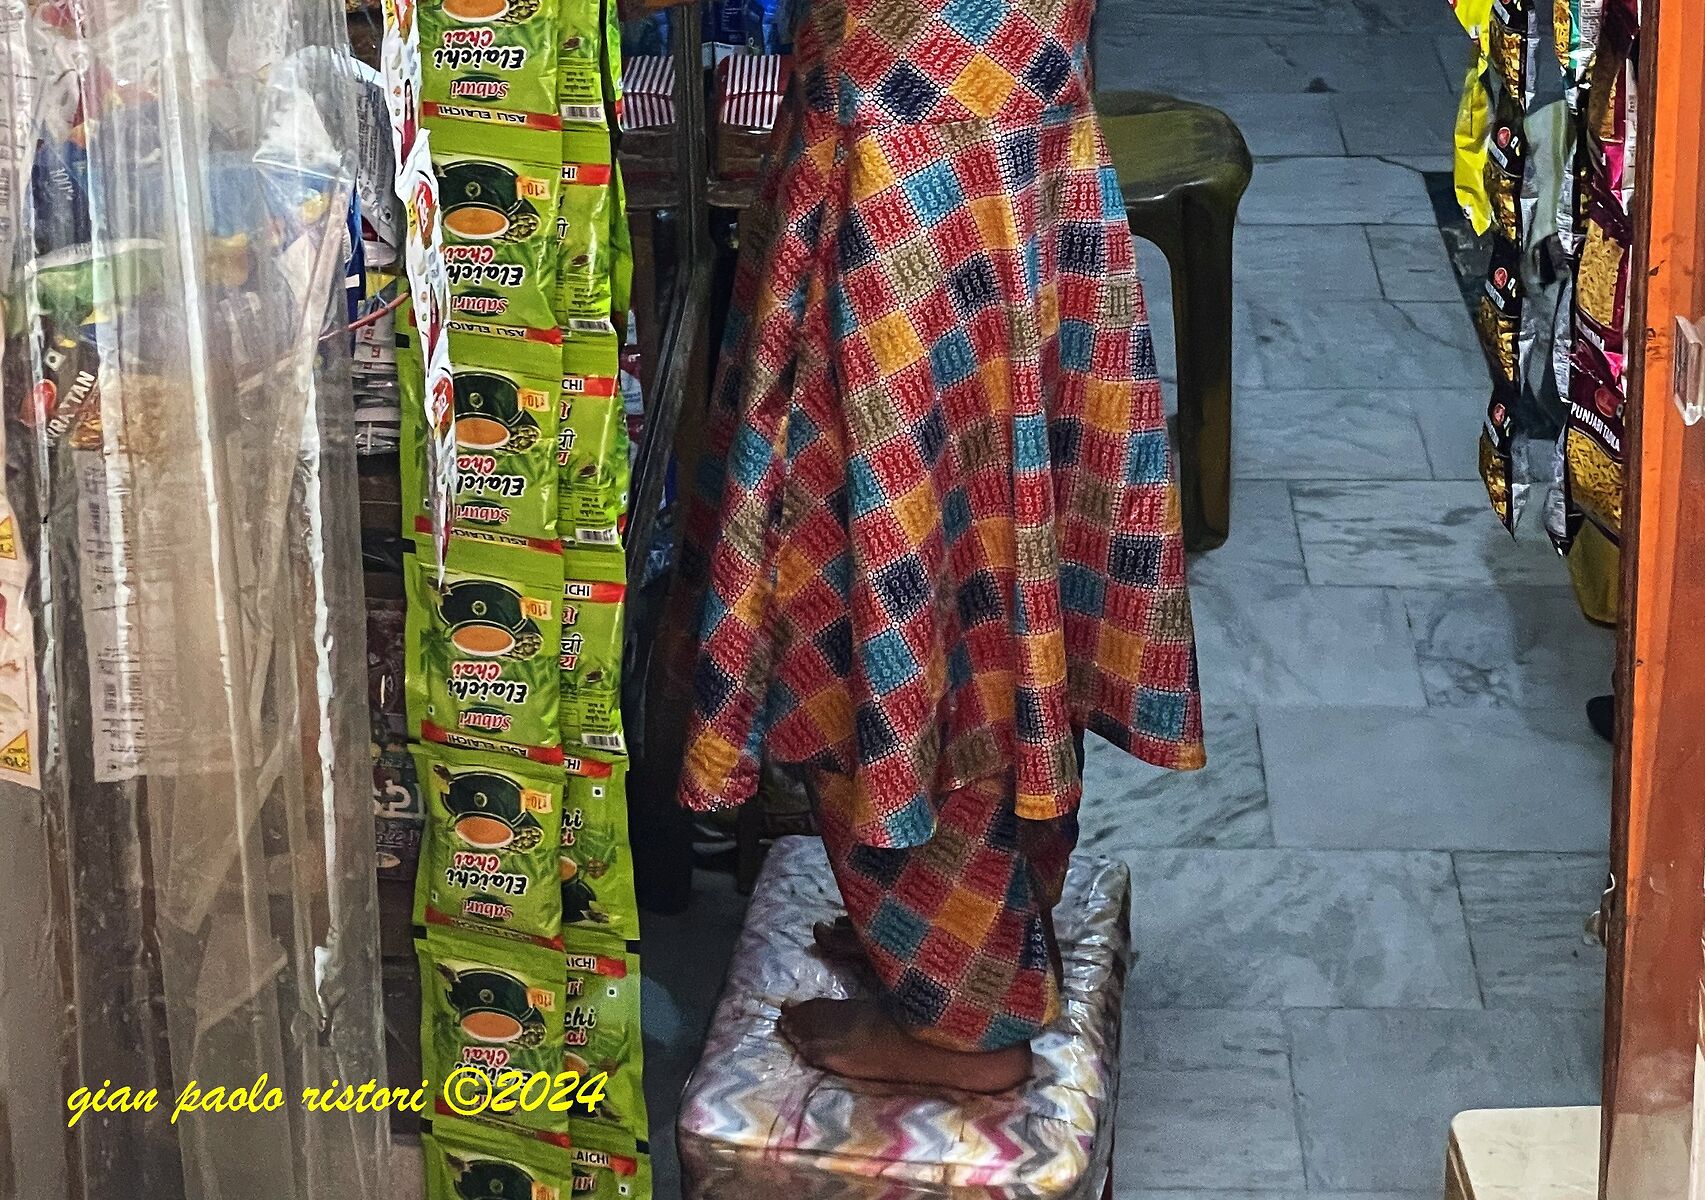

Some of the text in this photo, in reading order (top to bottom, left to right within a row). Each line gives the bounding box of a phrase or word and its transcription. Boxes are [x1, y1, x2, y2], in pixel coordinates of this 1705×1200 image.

[444, 29, 493, 46] Chai
[434, 47, 525, 69] Elaichi
[438, 106, 526, 123] ASLI ELAICHI
[444, 246, 494, 264] Chai
[446, 265, 523, 285] Elaich
[445, 322, 525, 337] ASLI ELAICH
[457, 455, 496, 474] Cha
[450, 528, 527, 546] ASLI ELAICH
[453, 661, 501, 679] Chai
[447, 678, 527, 704] Elaichi
[447, 734, 495, 750] ELAICHI
[453, 853, 500, 873] Chai
[445, 868, 527, 895] Elaichi
[463, 1048, 509, 1067] Chai
